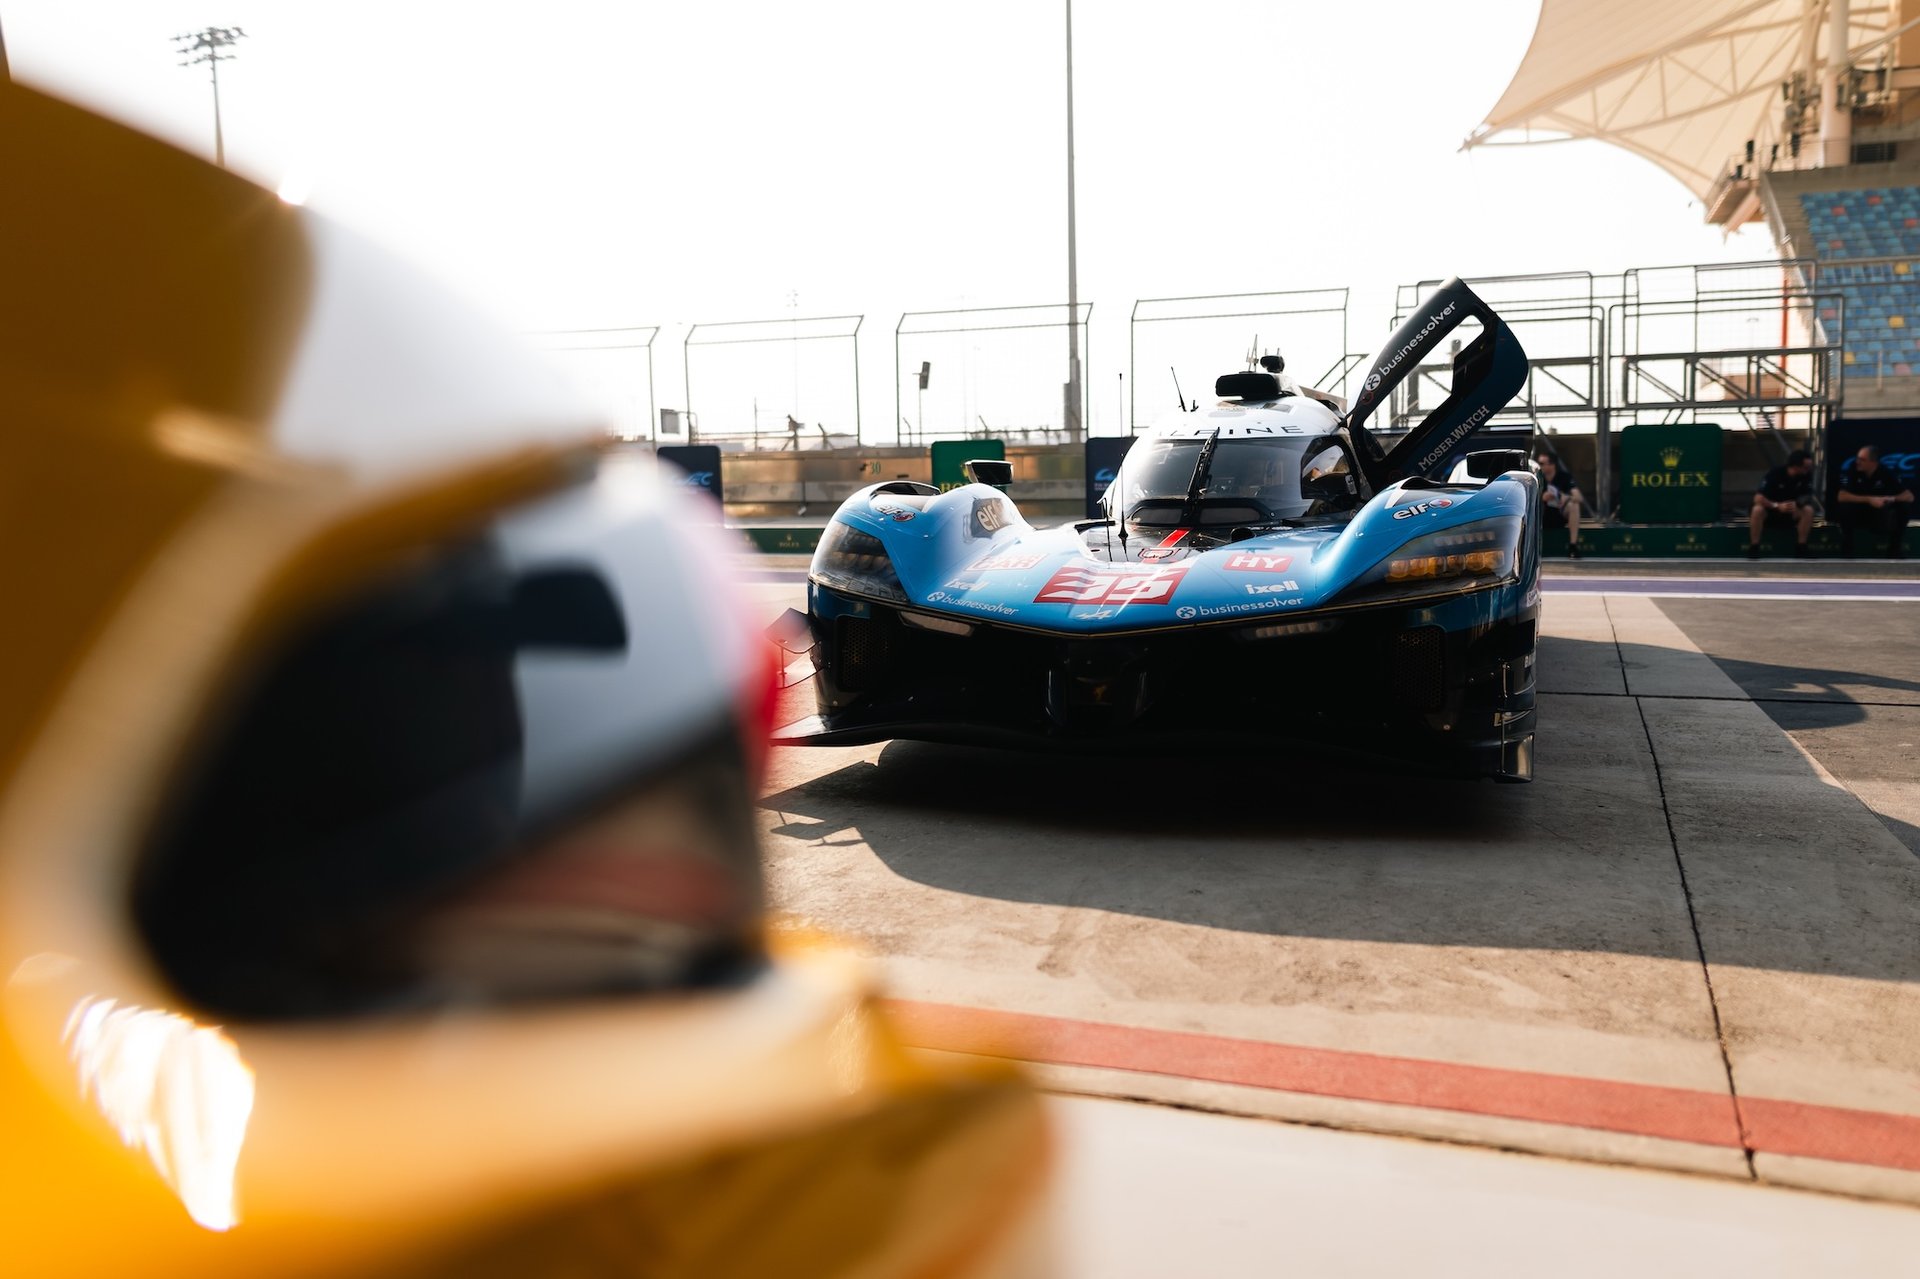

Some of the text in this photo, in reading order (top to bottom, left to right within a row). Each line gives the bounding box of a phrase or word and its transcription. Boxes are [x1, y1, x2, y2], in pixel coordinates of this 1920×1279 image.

[1378, 301, 1456, 376] businessolver
[1158, 424, 1304, 437] LPINE
[1417, 405, 1490, 471] MOSER.WATCH
[1631, 472, 1710, 488] ROLEX
[1393, 503, 1430, 521] elf
[1231, 556, 1287, 569] HY
[1245, 580, 1299, 595] ixell
[942, 594, 1020, 616] businessolver
[1200, 597, 1304, 616] businessolver
